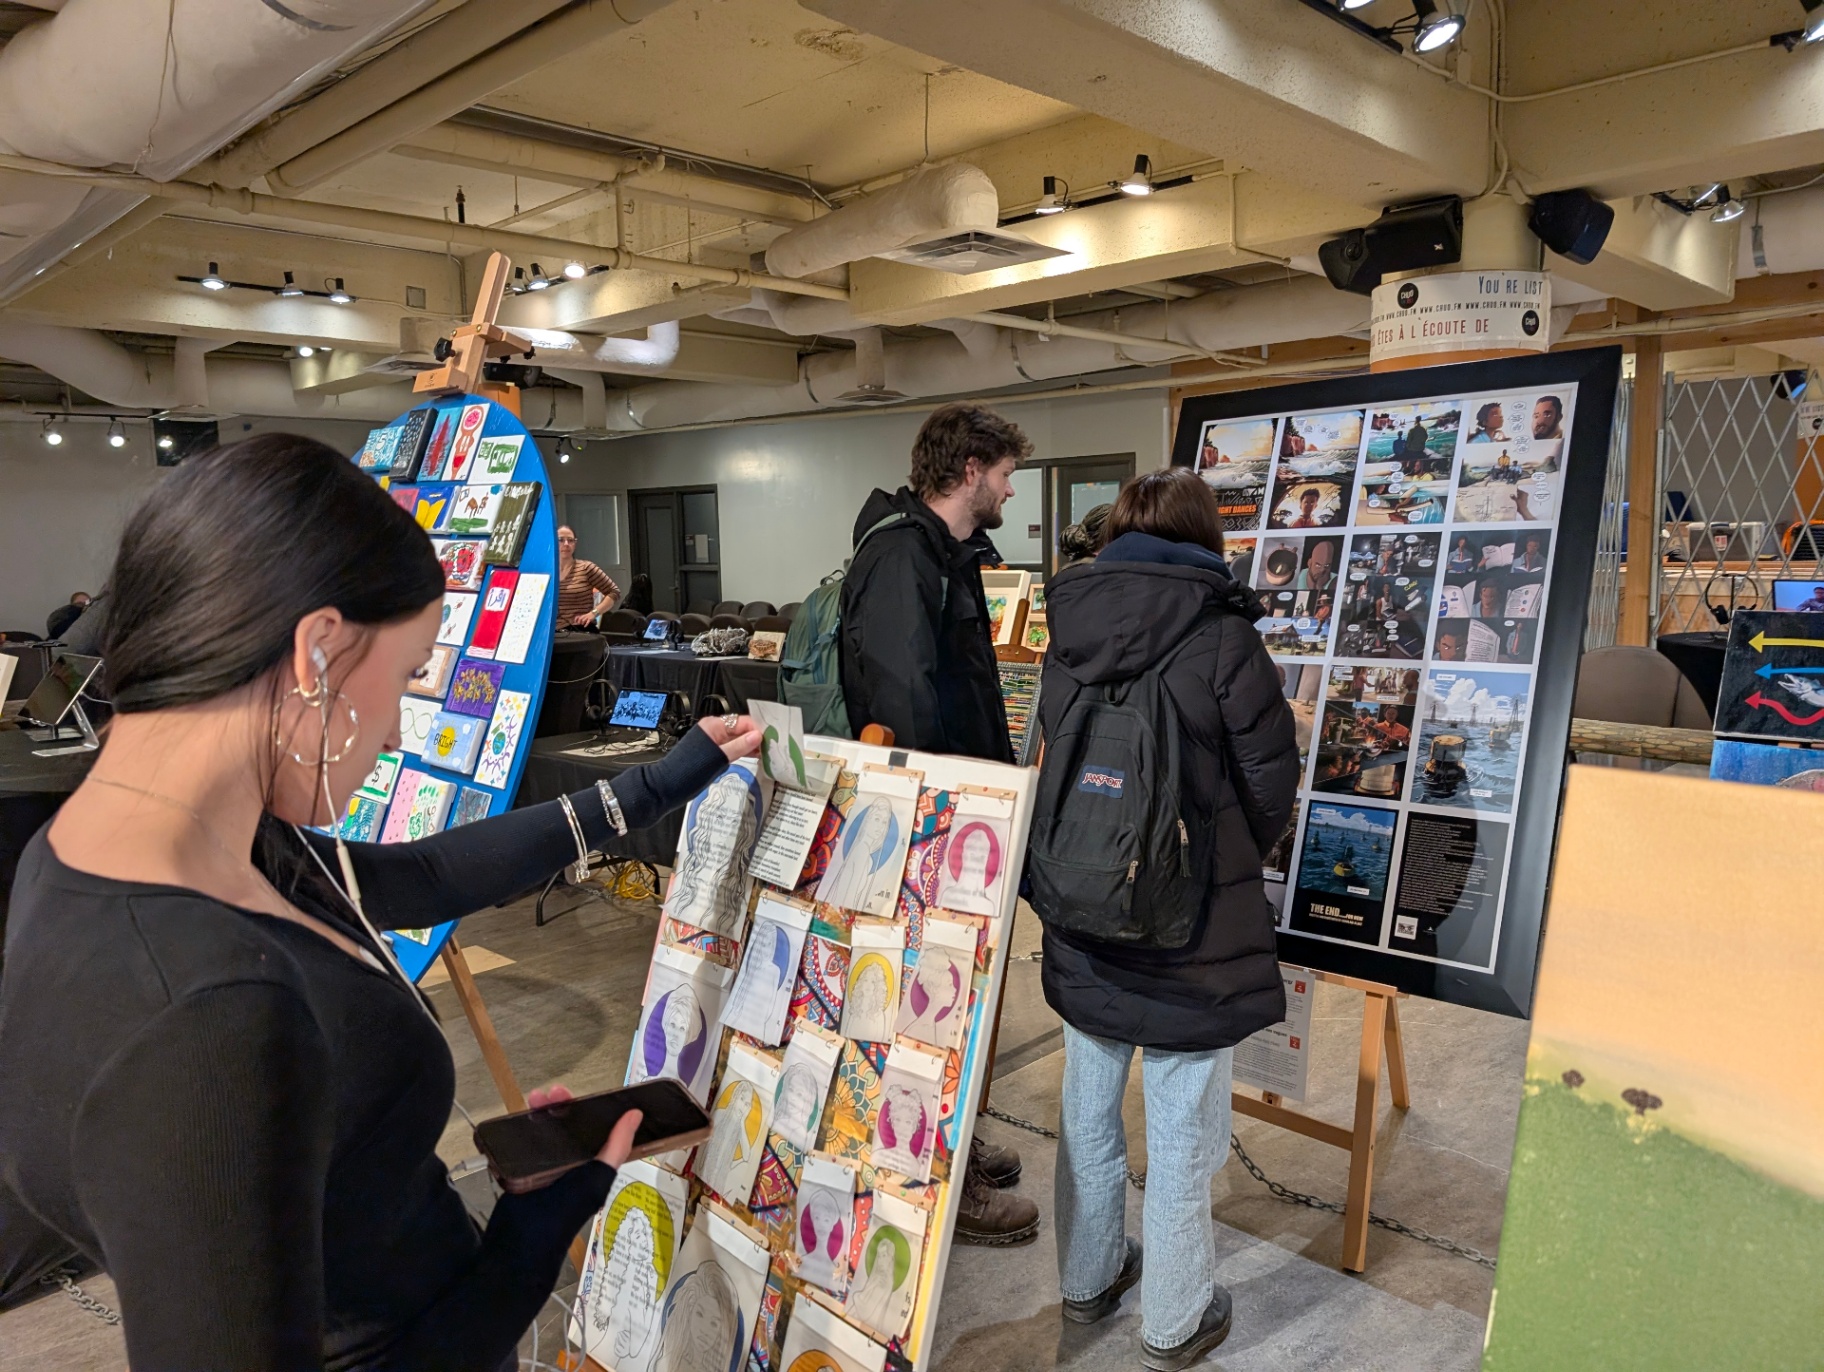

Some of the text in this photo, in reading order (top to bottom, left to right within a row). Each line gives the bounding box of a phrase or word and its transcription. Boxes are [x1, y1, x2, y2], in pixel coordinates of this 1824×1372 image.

[1475, 319, 1489, 333] DE
[1232, 504, 1257, 513] DANCES
[433, 733, 458, 750] BRIGHT
[1082, 772, 1123, 789] JANSPORT
[1310, 902, 1324, 914] THE
